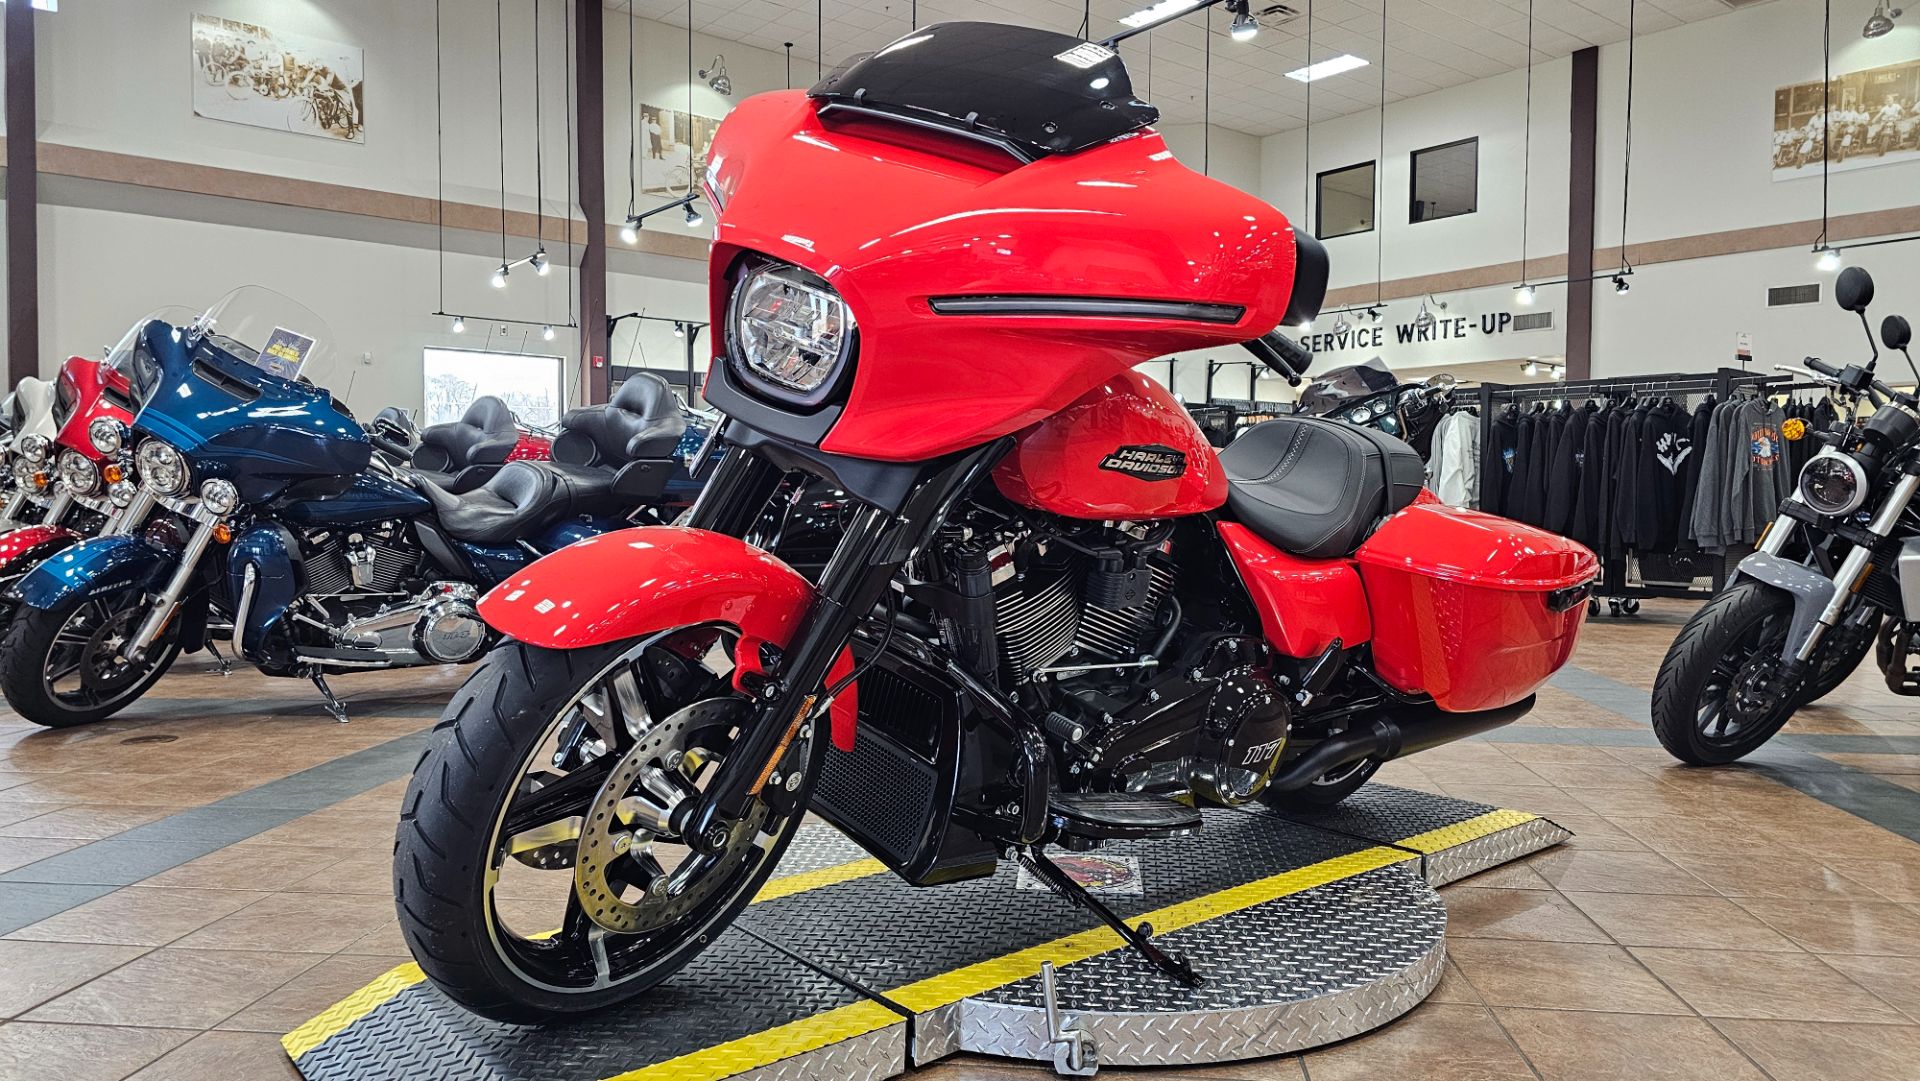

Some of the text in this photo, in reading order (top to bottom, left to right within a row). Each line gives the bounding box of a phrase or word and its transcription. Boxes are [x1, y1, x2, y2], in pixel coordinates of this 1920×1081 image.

[1300, 312, 1511, 352] SERVICE WRITE-UP
[1105, 459, 1184, 475] DAVIDSON
[1119, 449, 1181, 464] HARLEY
[1241, 737, 1283, 765] 117
